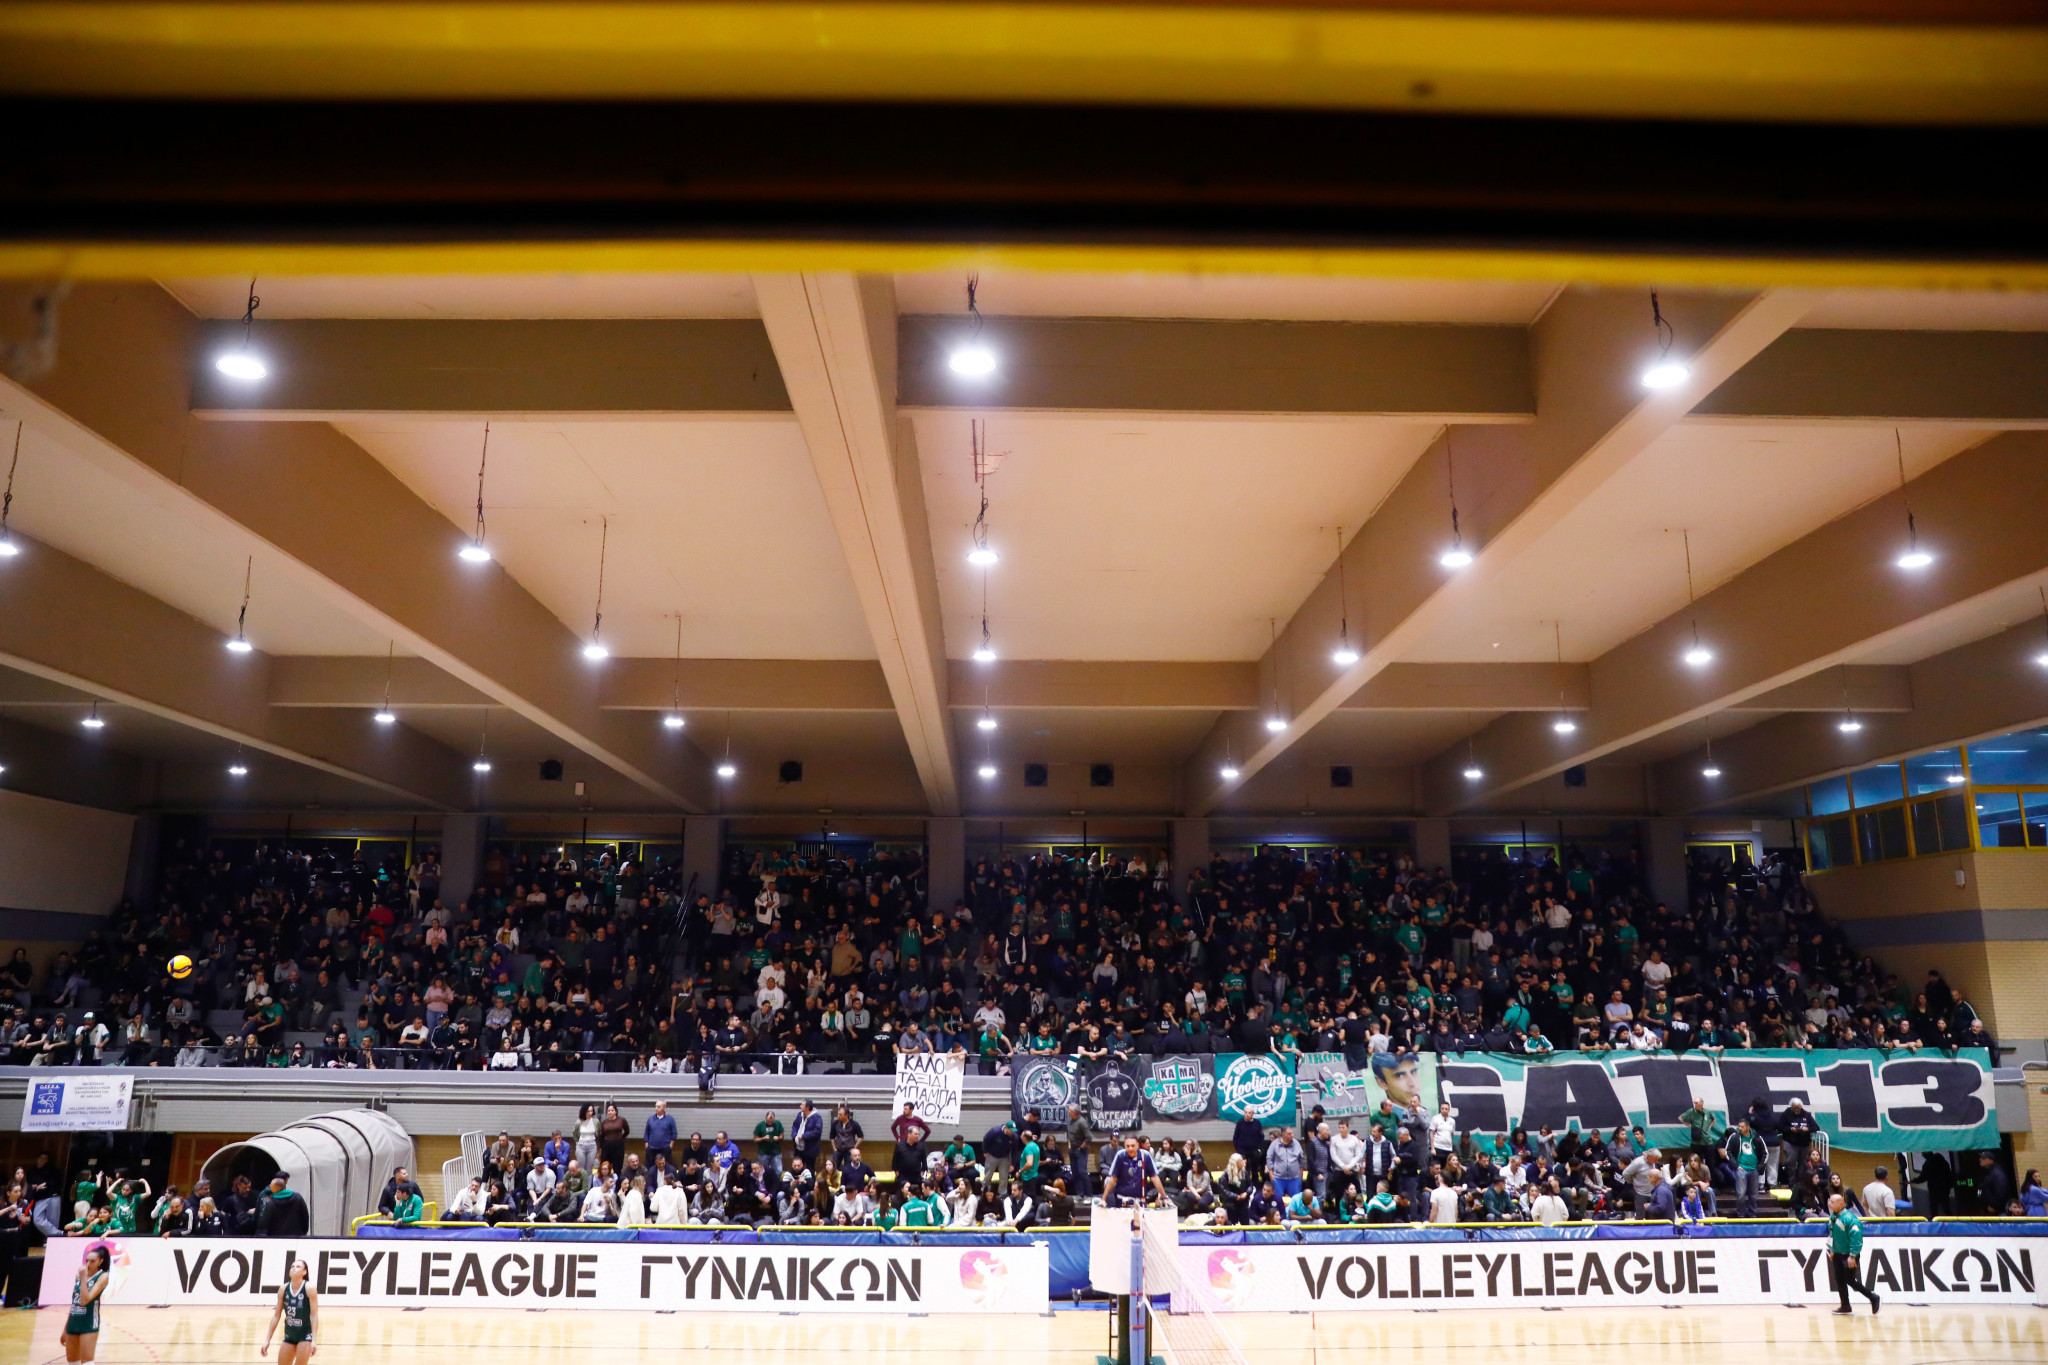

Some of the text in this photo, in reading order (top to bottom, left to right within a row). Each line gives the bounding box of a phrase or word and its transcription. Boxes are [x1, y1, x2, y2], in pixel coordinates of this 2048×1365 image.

[904, 1054, 945, 1075] ΚΑΛΟ
[898, 1071, 947, 1089] ΤΑΞΙΔΙ
[894, 1085, 957, 1106] ΜΠΑΜΠΑ
[641, 1255, 922, 1302] ΓΥΝΑΙΚΩΝ
[1297, 1250, 1717, 1298] VOLLEYLEAGUE
